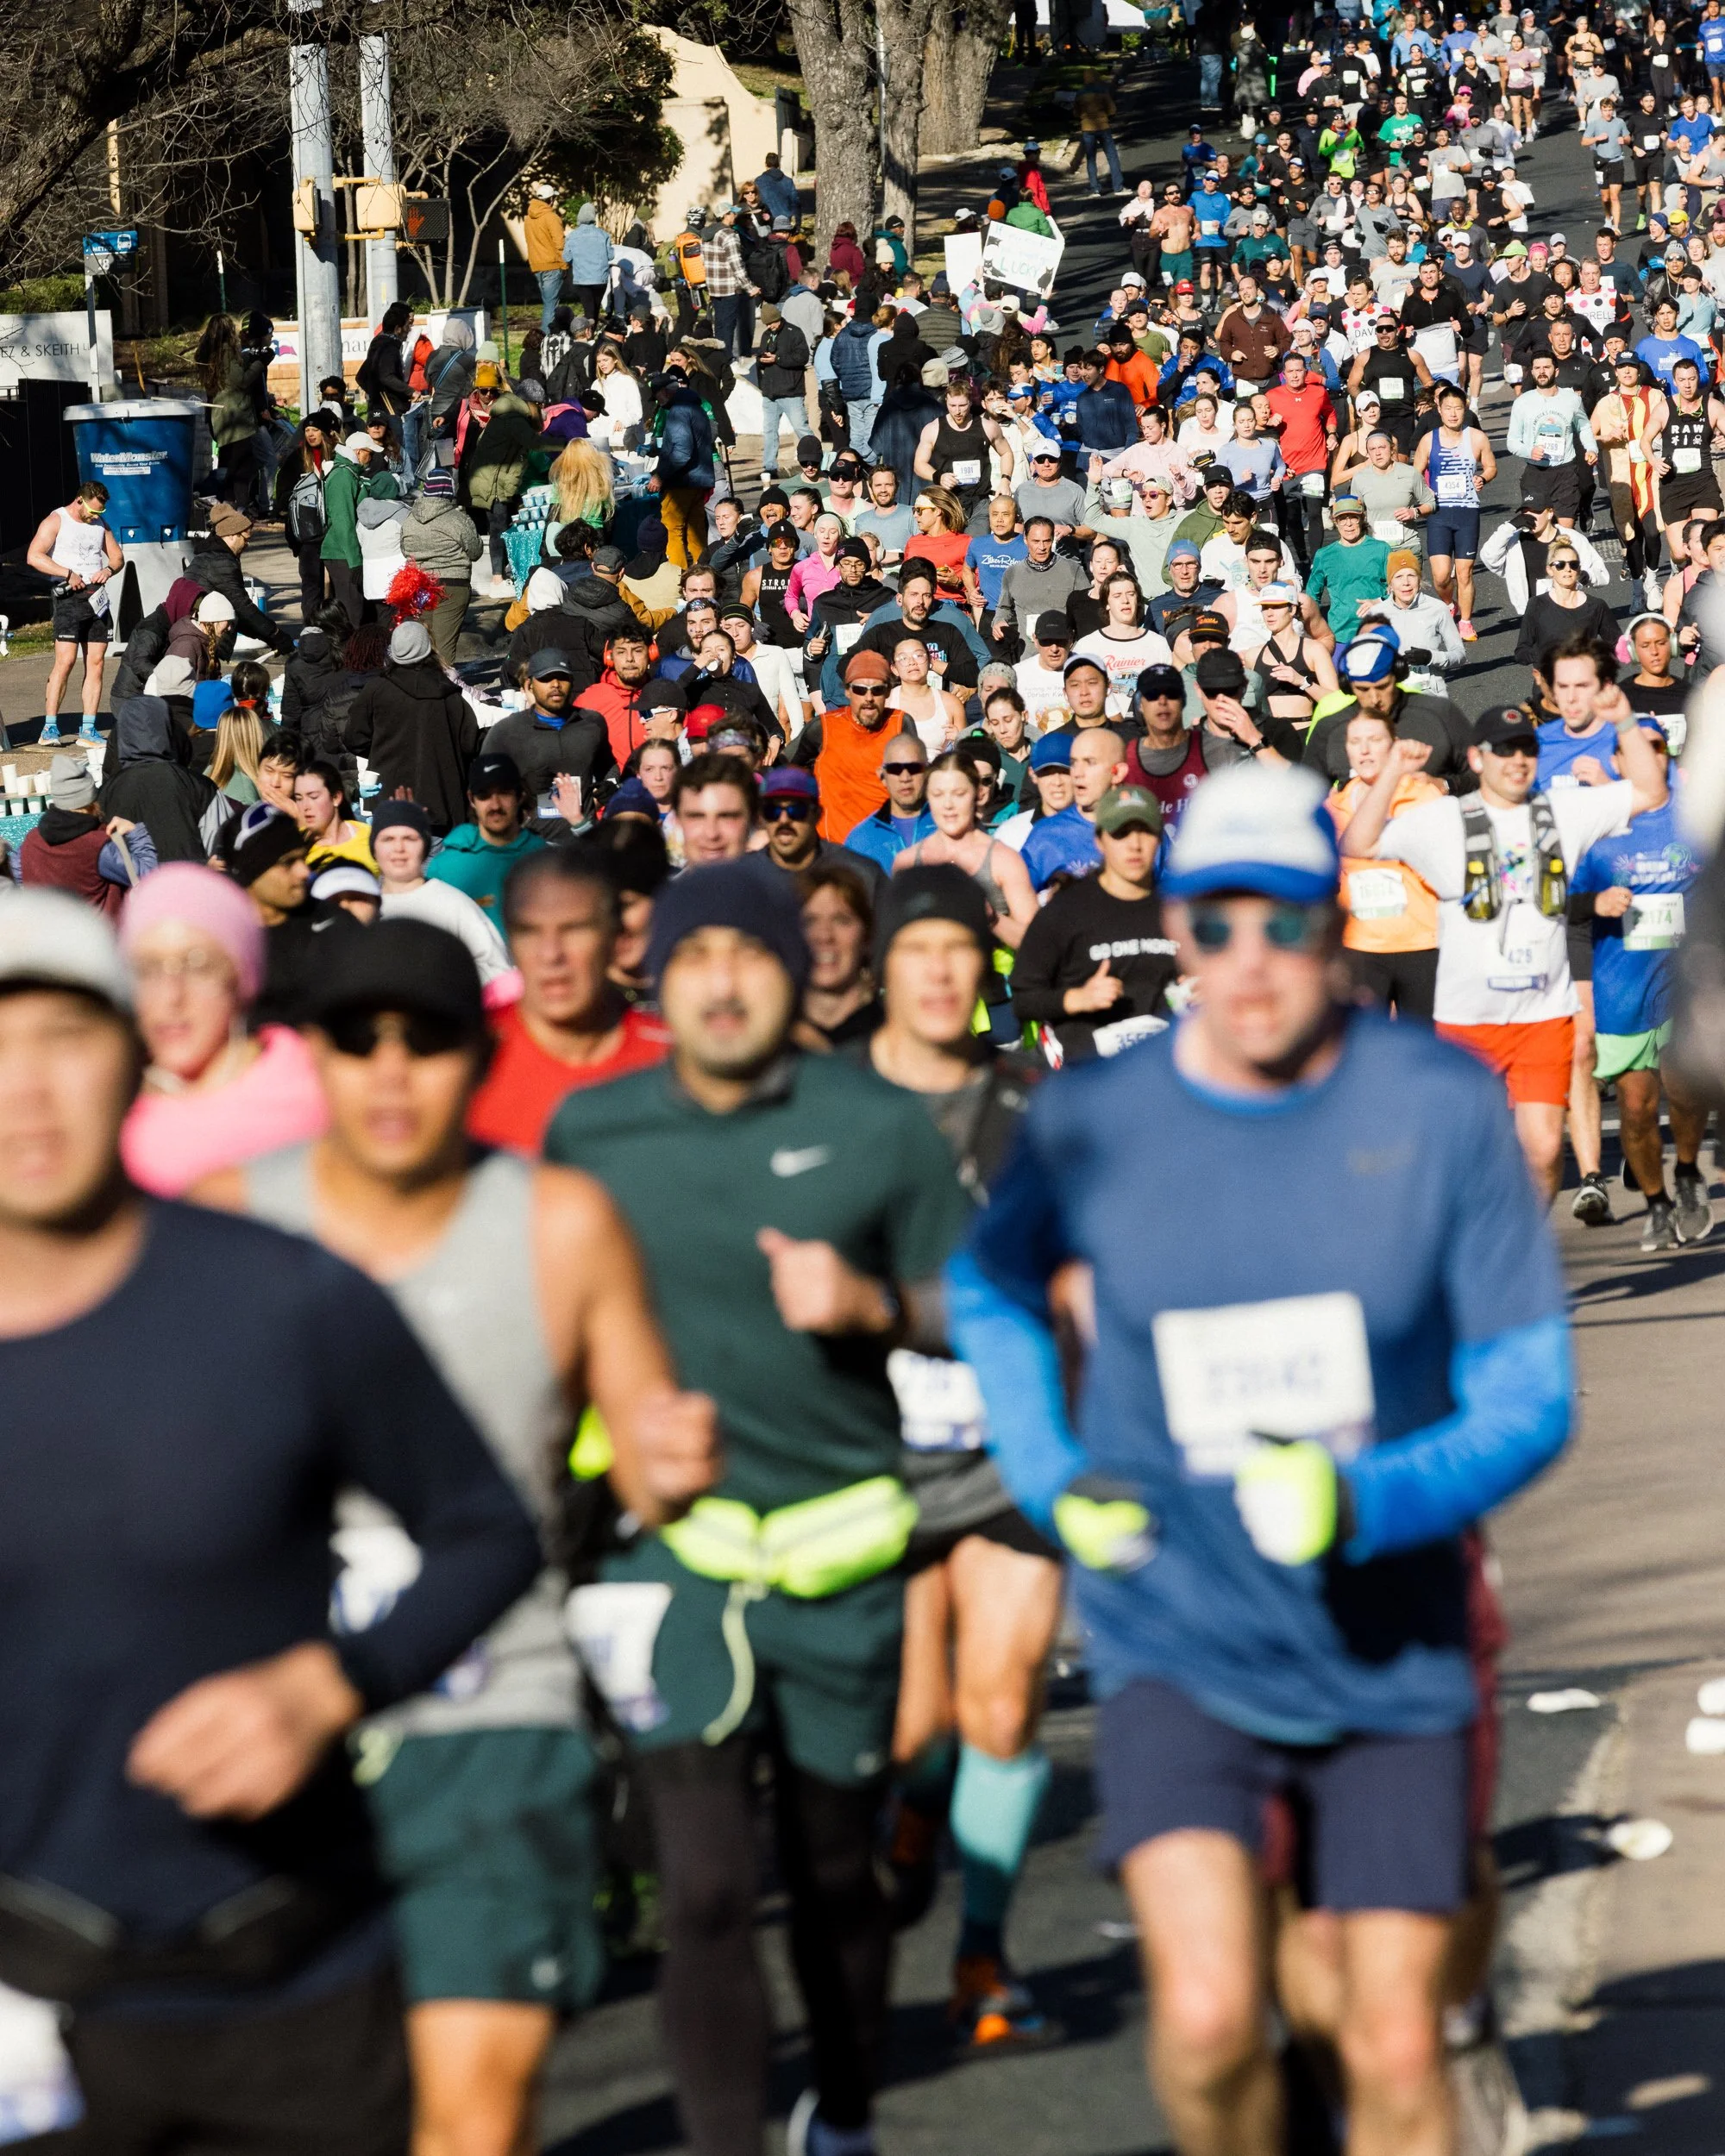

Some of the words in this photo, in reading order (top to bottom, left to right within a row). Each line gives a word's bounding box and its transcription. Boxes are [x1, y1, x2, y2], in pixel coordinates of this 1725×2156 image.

[21, 345, 31, 357] &
[35, 343, 79, 357] SKEITH
[1672, 424, 1704, 434] RAW
[1104, 655, 1146, 671] Rainier
[1089, 943, 1111, 961] GO
[1111, 939, 1139, 957] ONE
[1139, 938, 1178, 956] MORE
